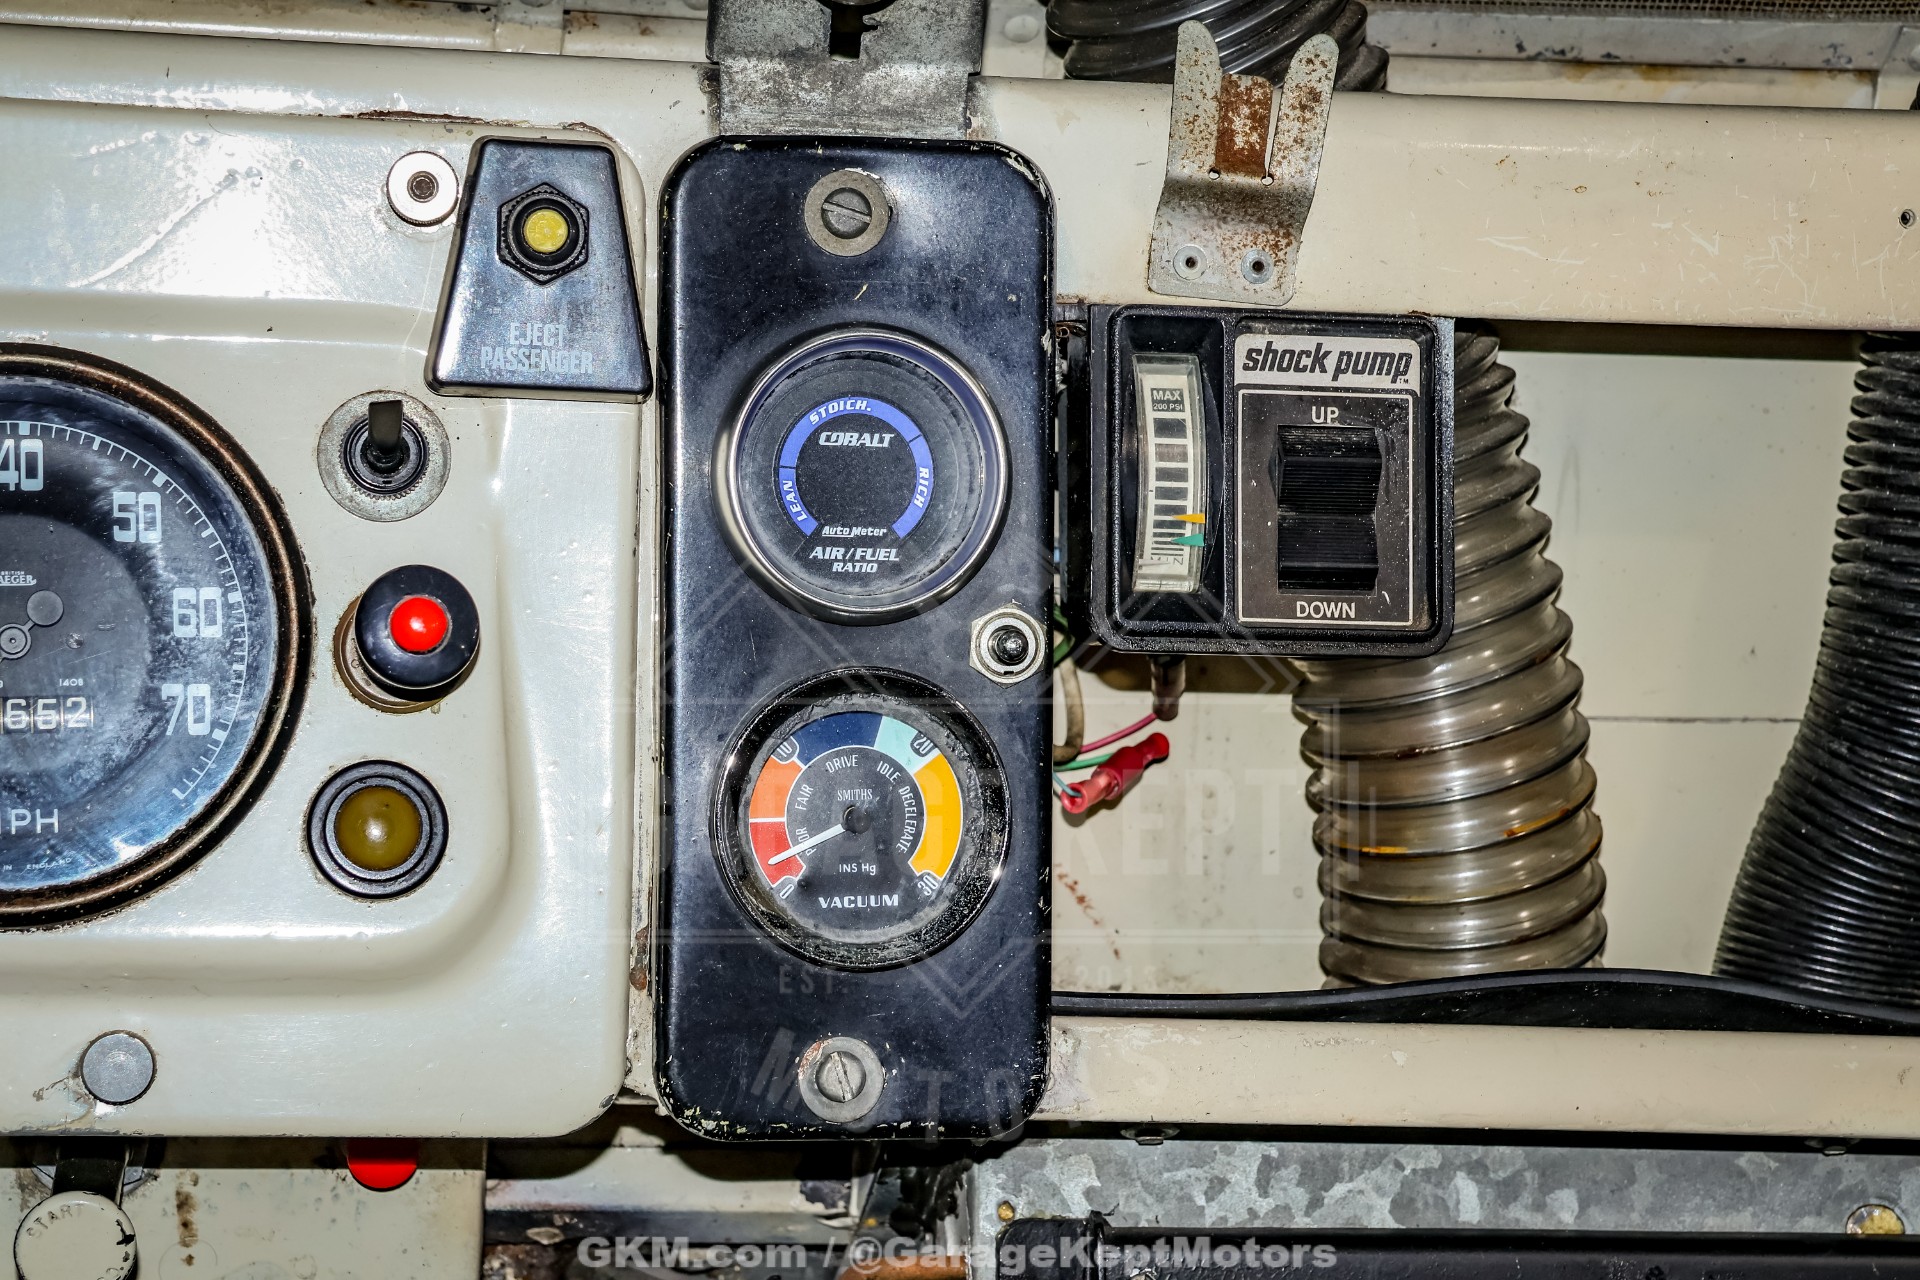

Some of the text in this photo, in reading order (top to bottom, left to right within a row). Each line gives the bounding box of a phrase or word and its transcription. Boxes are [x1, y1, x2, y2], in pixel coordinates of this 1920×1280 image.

[509, 323, 567, 347] EJECT
[481, 346, 593, 374] PASSENGER
[1242, 341, 1335, 374] shock
[1332, 351, 1413, 384] pump
[1153, 390, 1182, 401] MAX
[1153, 403, 1184, 411] 200 PSI
[809, 399, 872, 425] STOICH.
[1311, 406, 1340, 424] UP
[818, 431, 894, 448] COBALT
[0, 438, 44, 491] 40
[913, 466, 929, 509] RICH
[782, 480, 808, 522] LEAN
[113, 491, 162, 543] 50
[832, 562, 878, 573] RATIO
[173, 587, 223, 638] 60
[1296, 601, 1356, 619] DOWN
[161, 683, 212, 736] 70
[826, 754, 859, 774] DRIVE
[876, 760, 900, 784] IDLE
[795, 783, 814, 811] FAIR
[837, 788, 873, 801] SMITHS
[897, 785, 918, 854] DECELERATE
[795, 826, 817, 856] POR
[838, 863, 877, 876] INS Hg
[779, 883, 795, 899] 0
[818, 894, 899, 909] VACUUM
